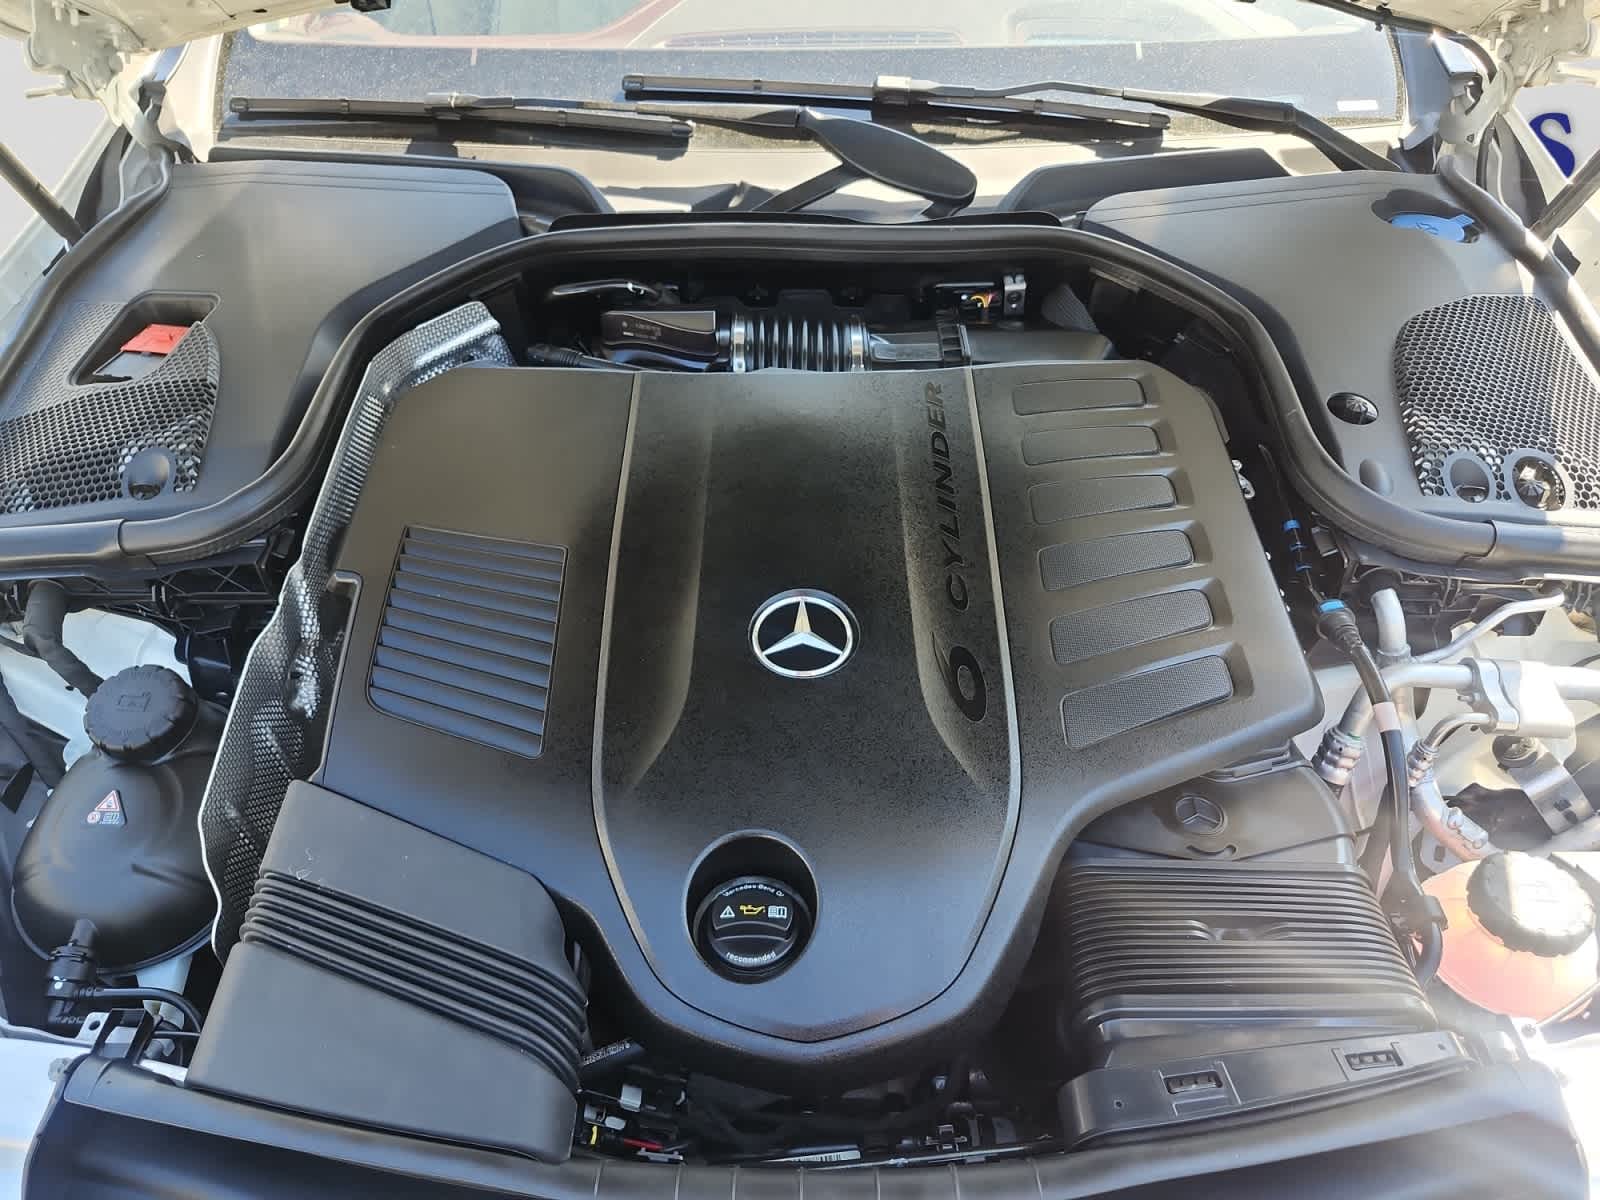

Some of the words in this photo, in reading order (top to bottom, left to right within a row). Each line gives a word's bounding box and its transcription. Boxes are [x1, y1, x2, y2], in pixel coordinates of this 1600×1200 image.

[925, 381, 969, 612] CYLINDER
[932, 632, 987, 722] 6
[726, 950, 777, 962] recommended
